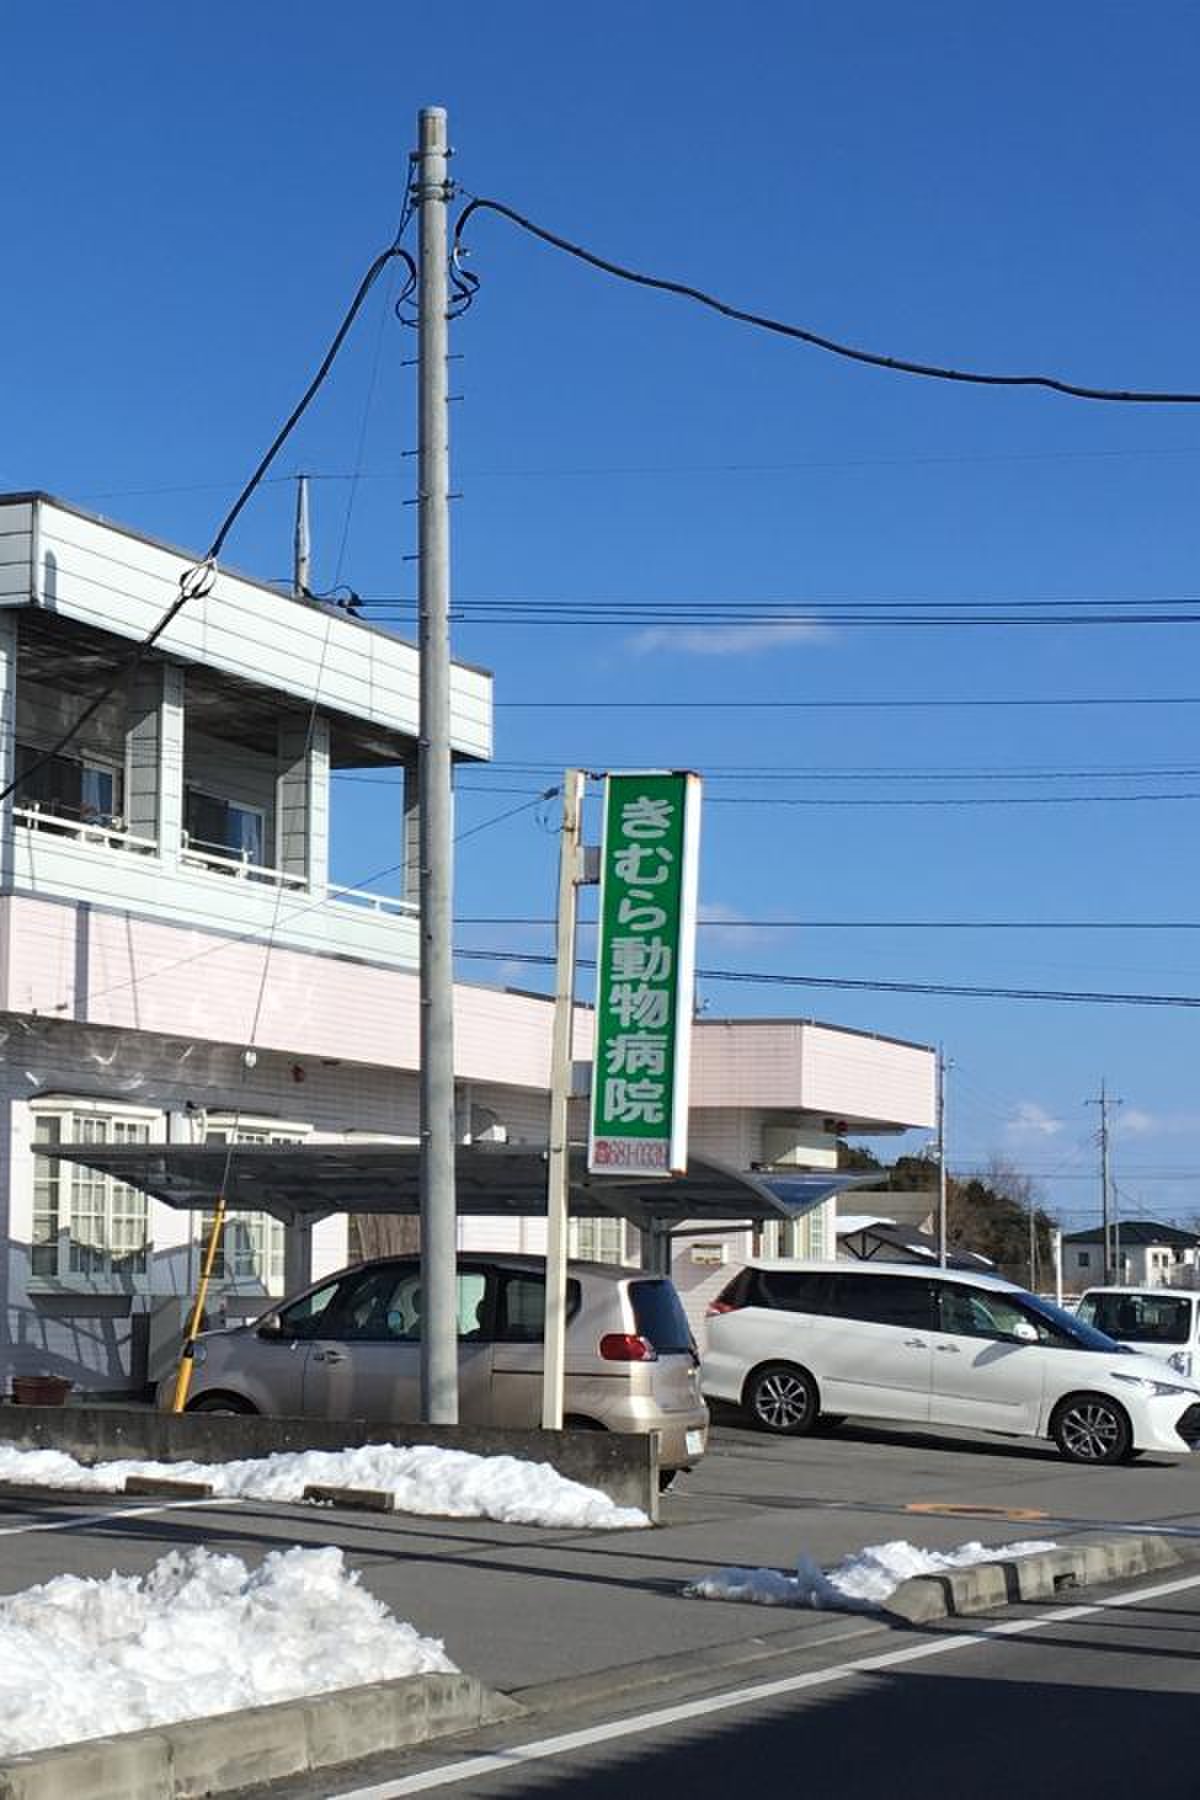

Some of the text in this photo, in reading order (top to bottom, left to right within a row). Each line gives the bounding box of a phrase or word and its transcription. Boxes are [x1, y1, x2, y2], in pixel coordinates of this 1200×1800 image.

[604, 796, 674, 1123] きむら動物病院
